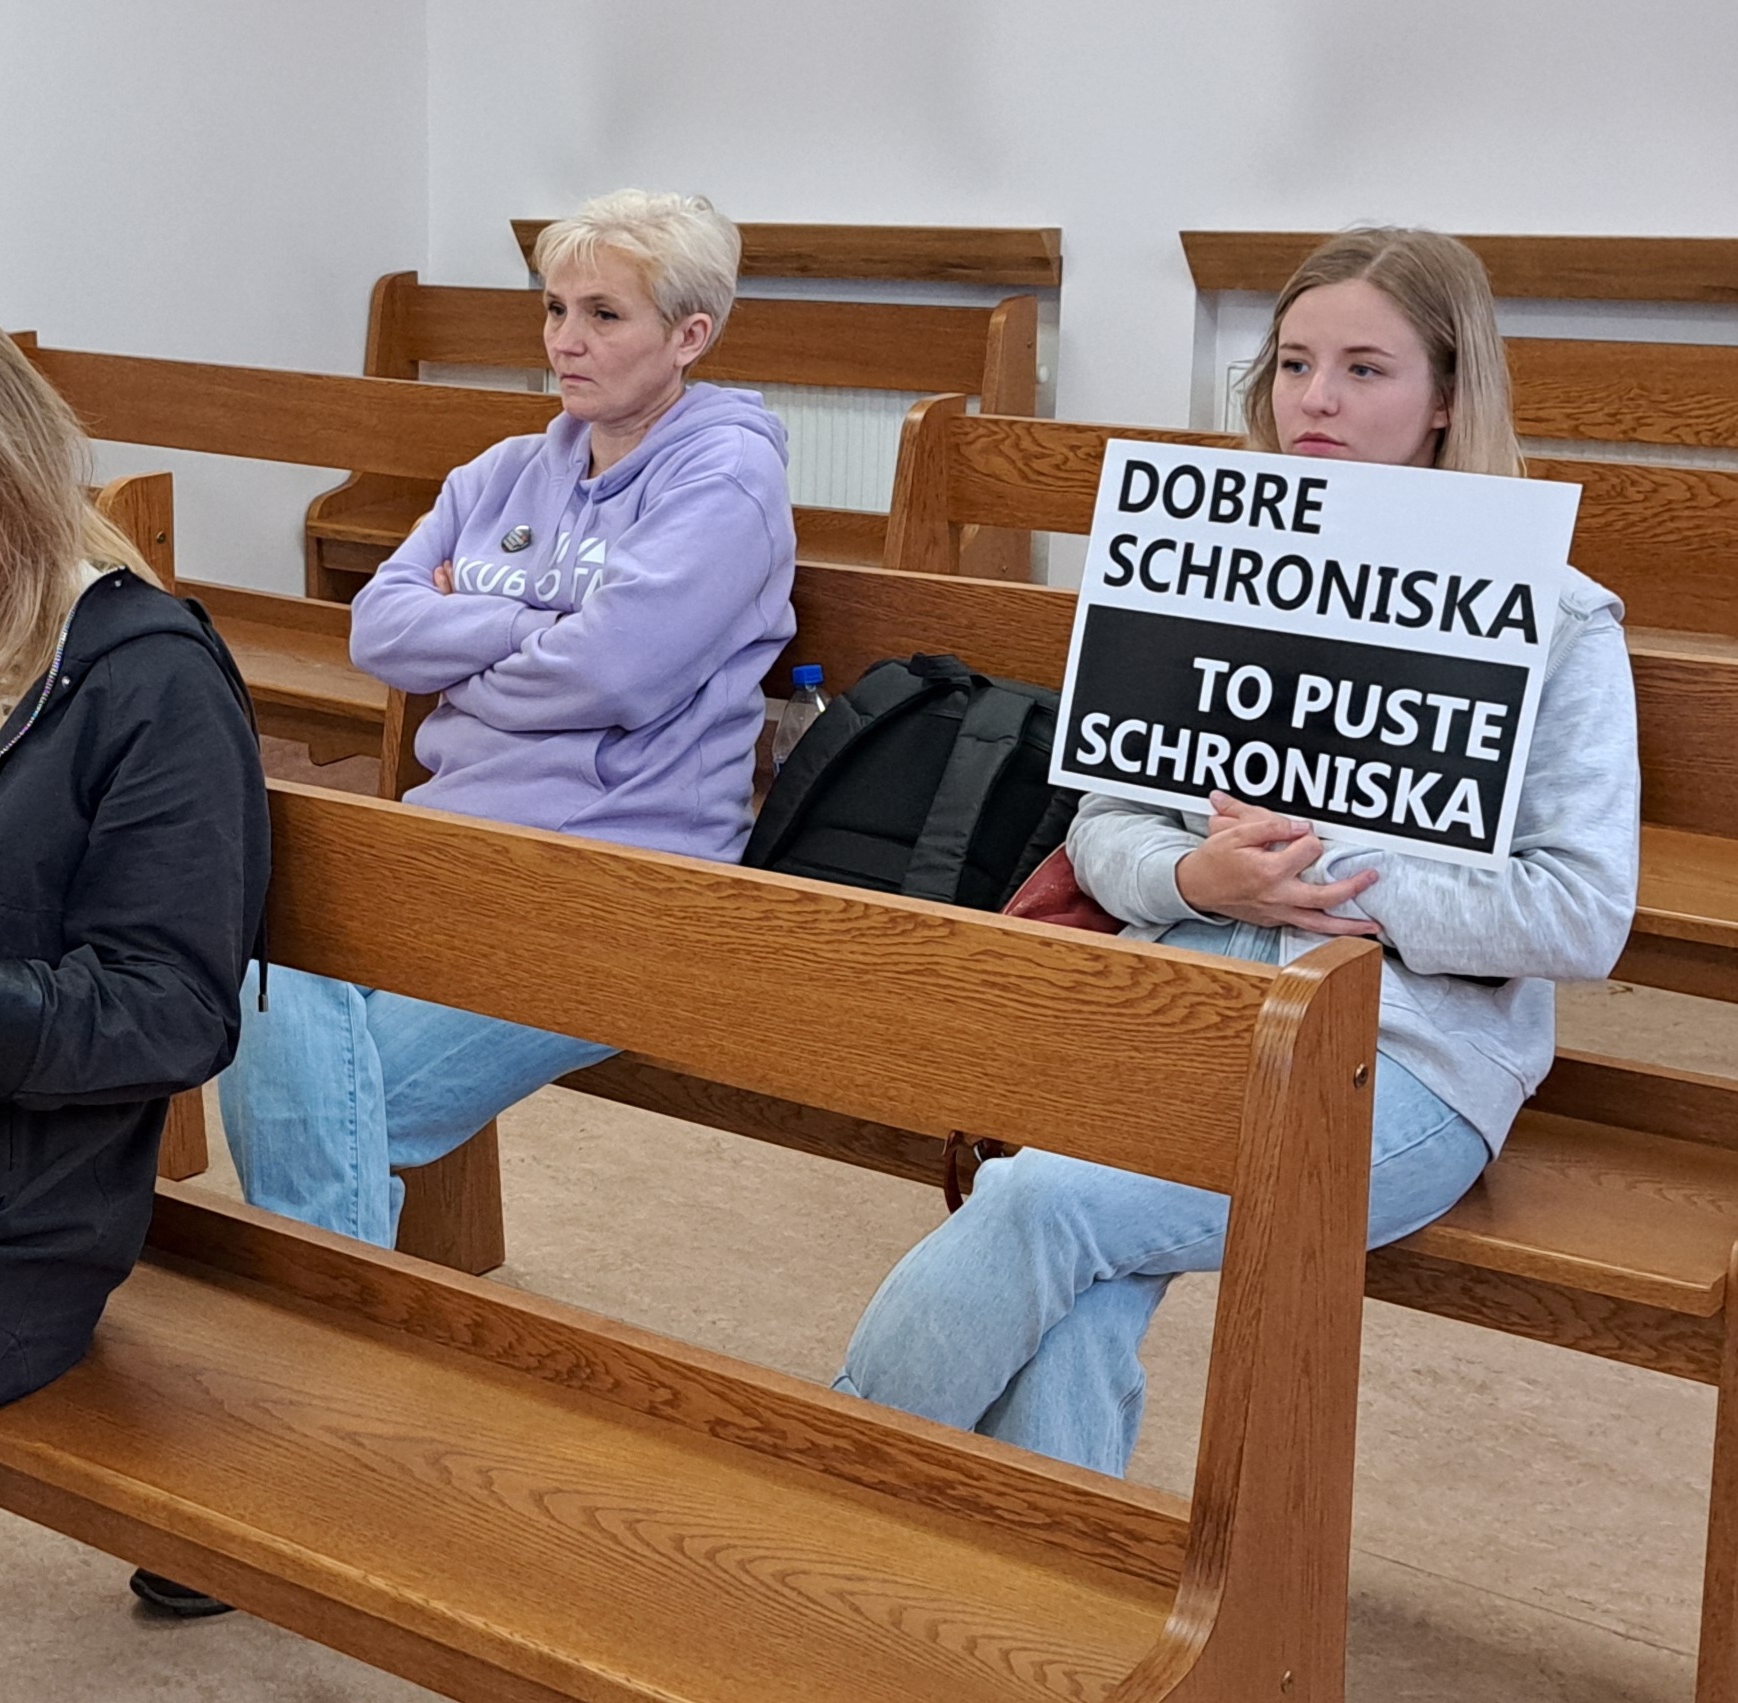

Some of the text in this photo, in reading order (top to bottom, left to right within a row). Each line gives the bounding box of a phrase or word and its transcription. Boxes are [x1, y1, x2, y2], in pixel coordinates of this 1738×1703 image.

[1118, 459, 1328, 534] DOBRE
[1103, 533, 1540, 645] SCHRONISKA
[1192, 657, 1509, 762] TO PUSTE
[1075, 712, 1486, 840] SCHRONISKA
